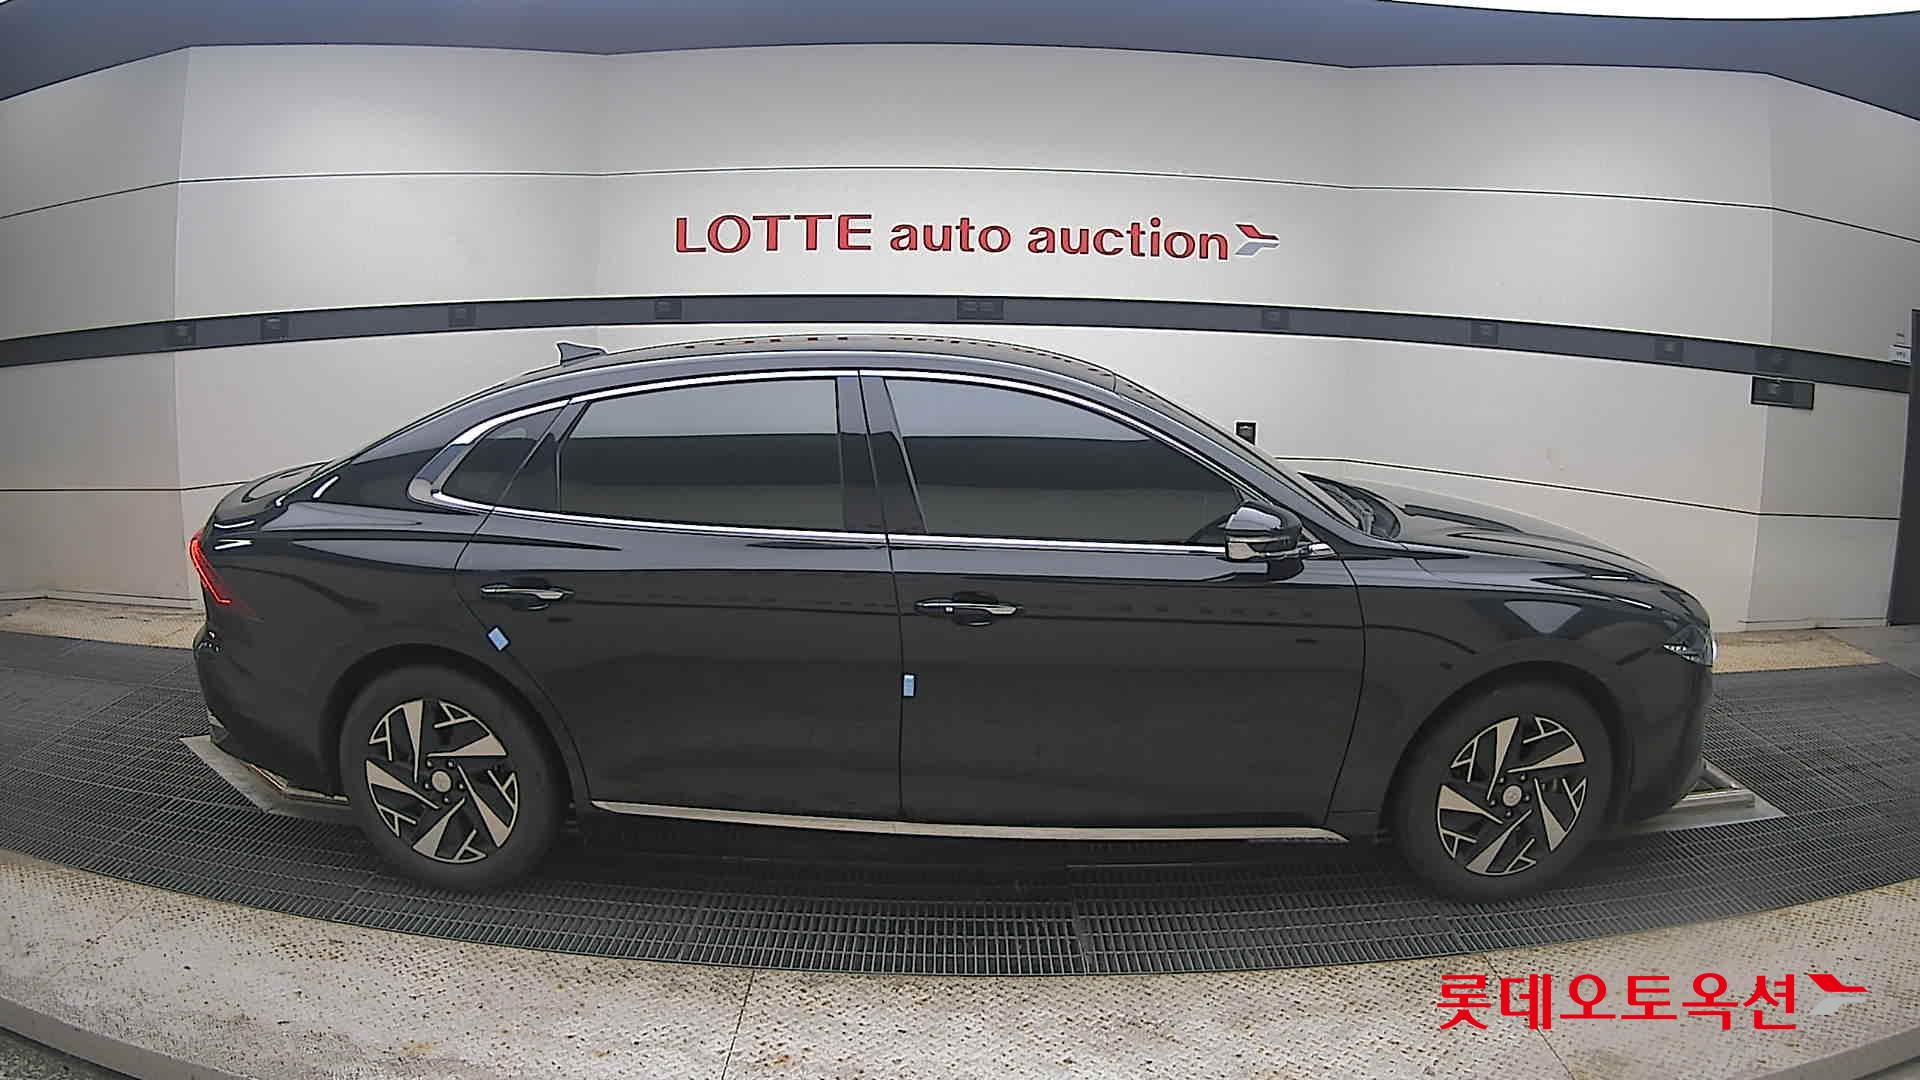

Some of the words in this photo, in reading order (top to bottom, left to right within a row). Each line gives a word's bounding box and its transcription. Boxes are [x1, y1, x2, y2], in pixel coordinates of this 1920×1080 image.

[676, 214, 872, 253] LOTTE
[889, 217, 1012, 253] auto
[1027, 217, 1229, 260] auction
